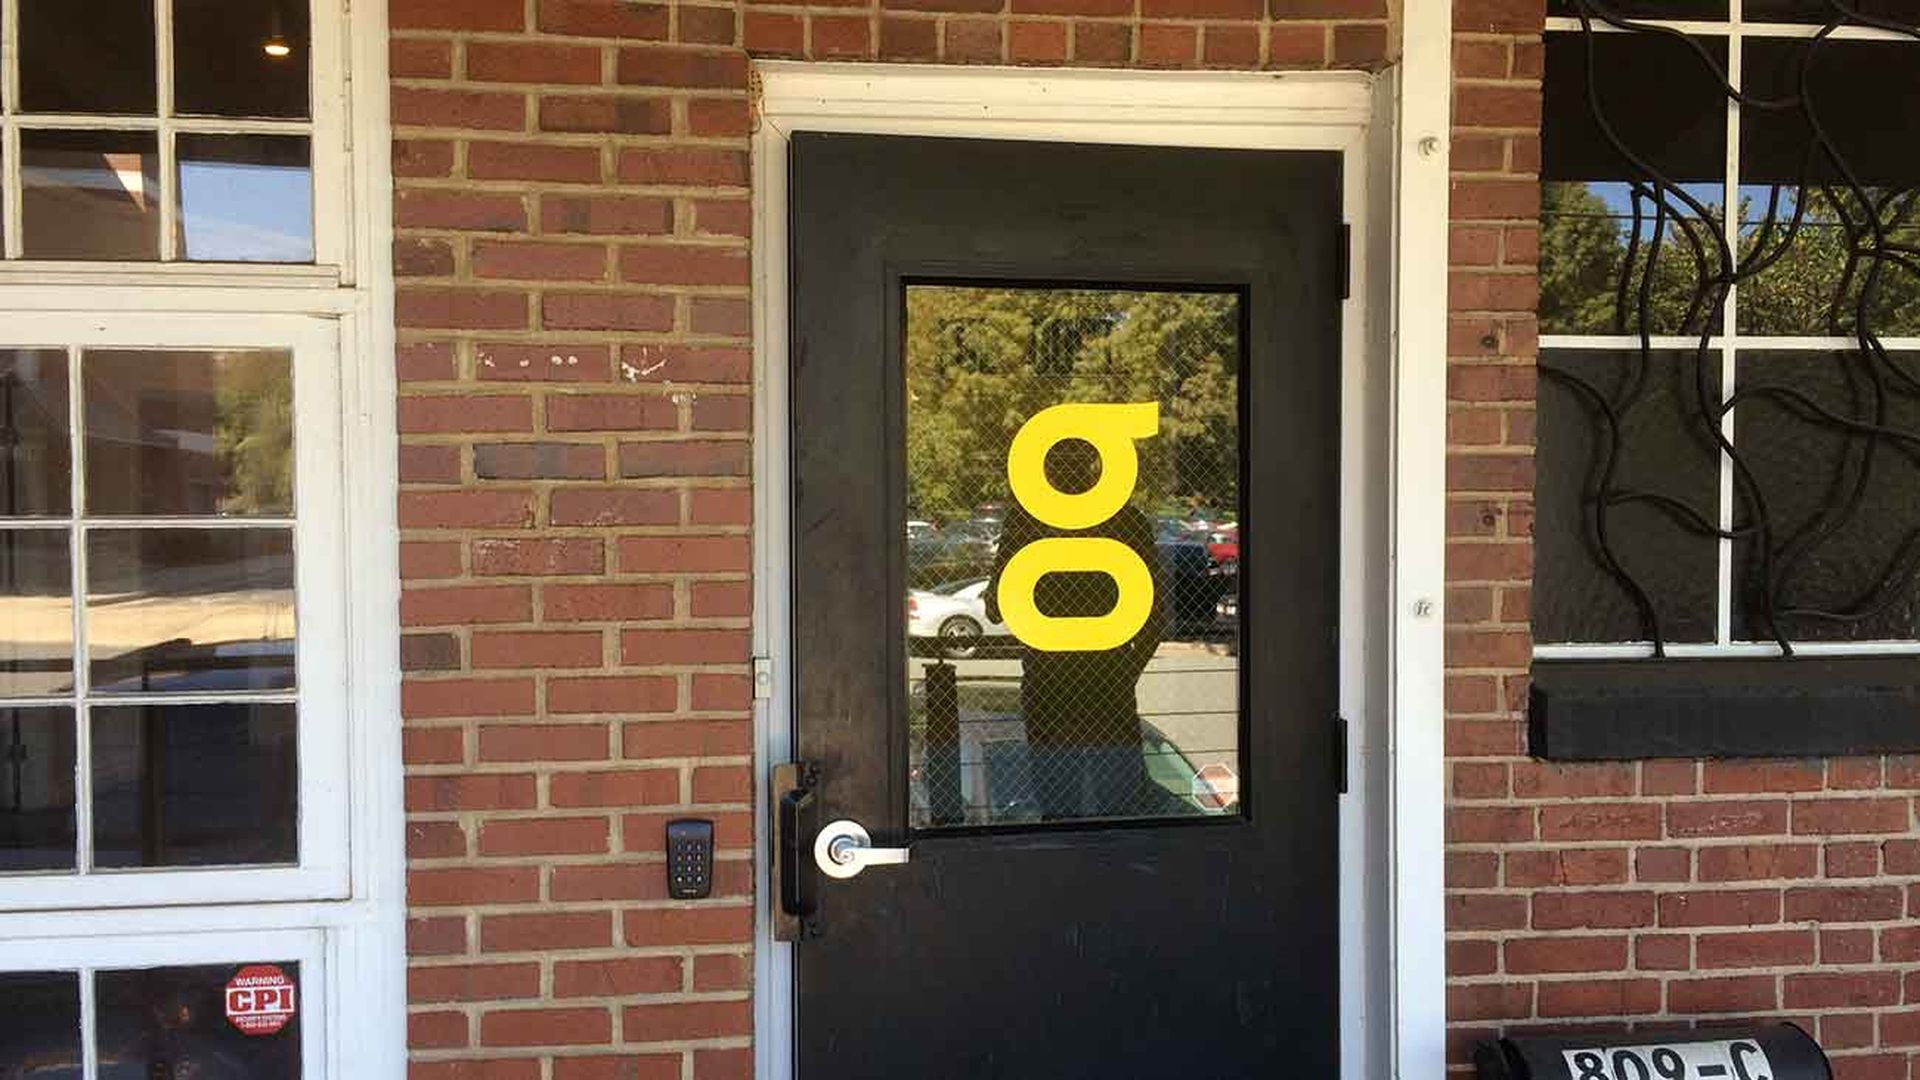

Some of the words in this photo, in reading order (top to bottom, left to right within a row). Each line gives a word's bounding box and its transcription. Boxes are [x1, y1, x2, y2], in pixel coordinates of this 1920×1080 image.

[233, 975, 285, 987] WARNING
[228, 989, 291, 1012] CPI
[1573, 1040, 1769, 1080] 809-C
